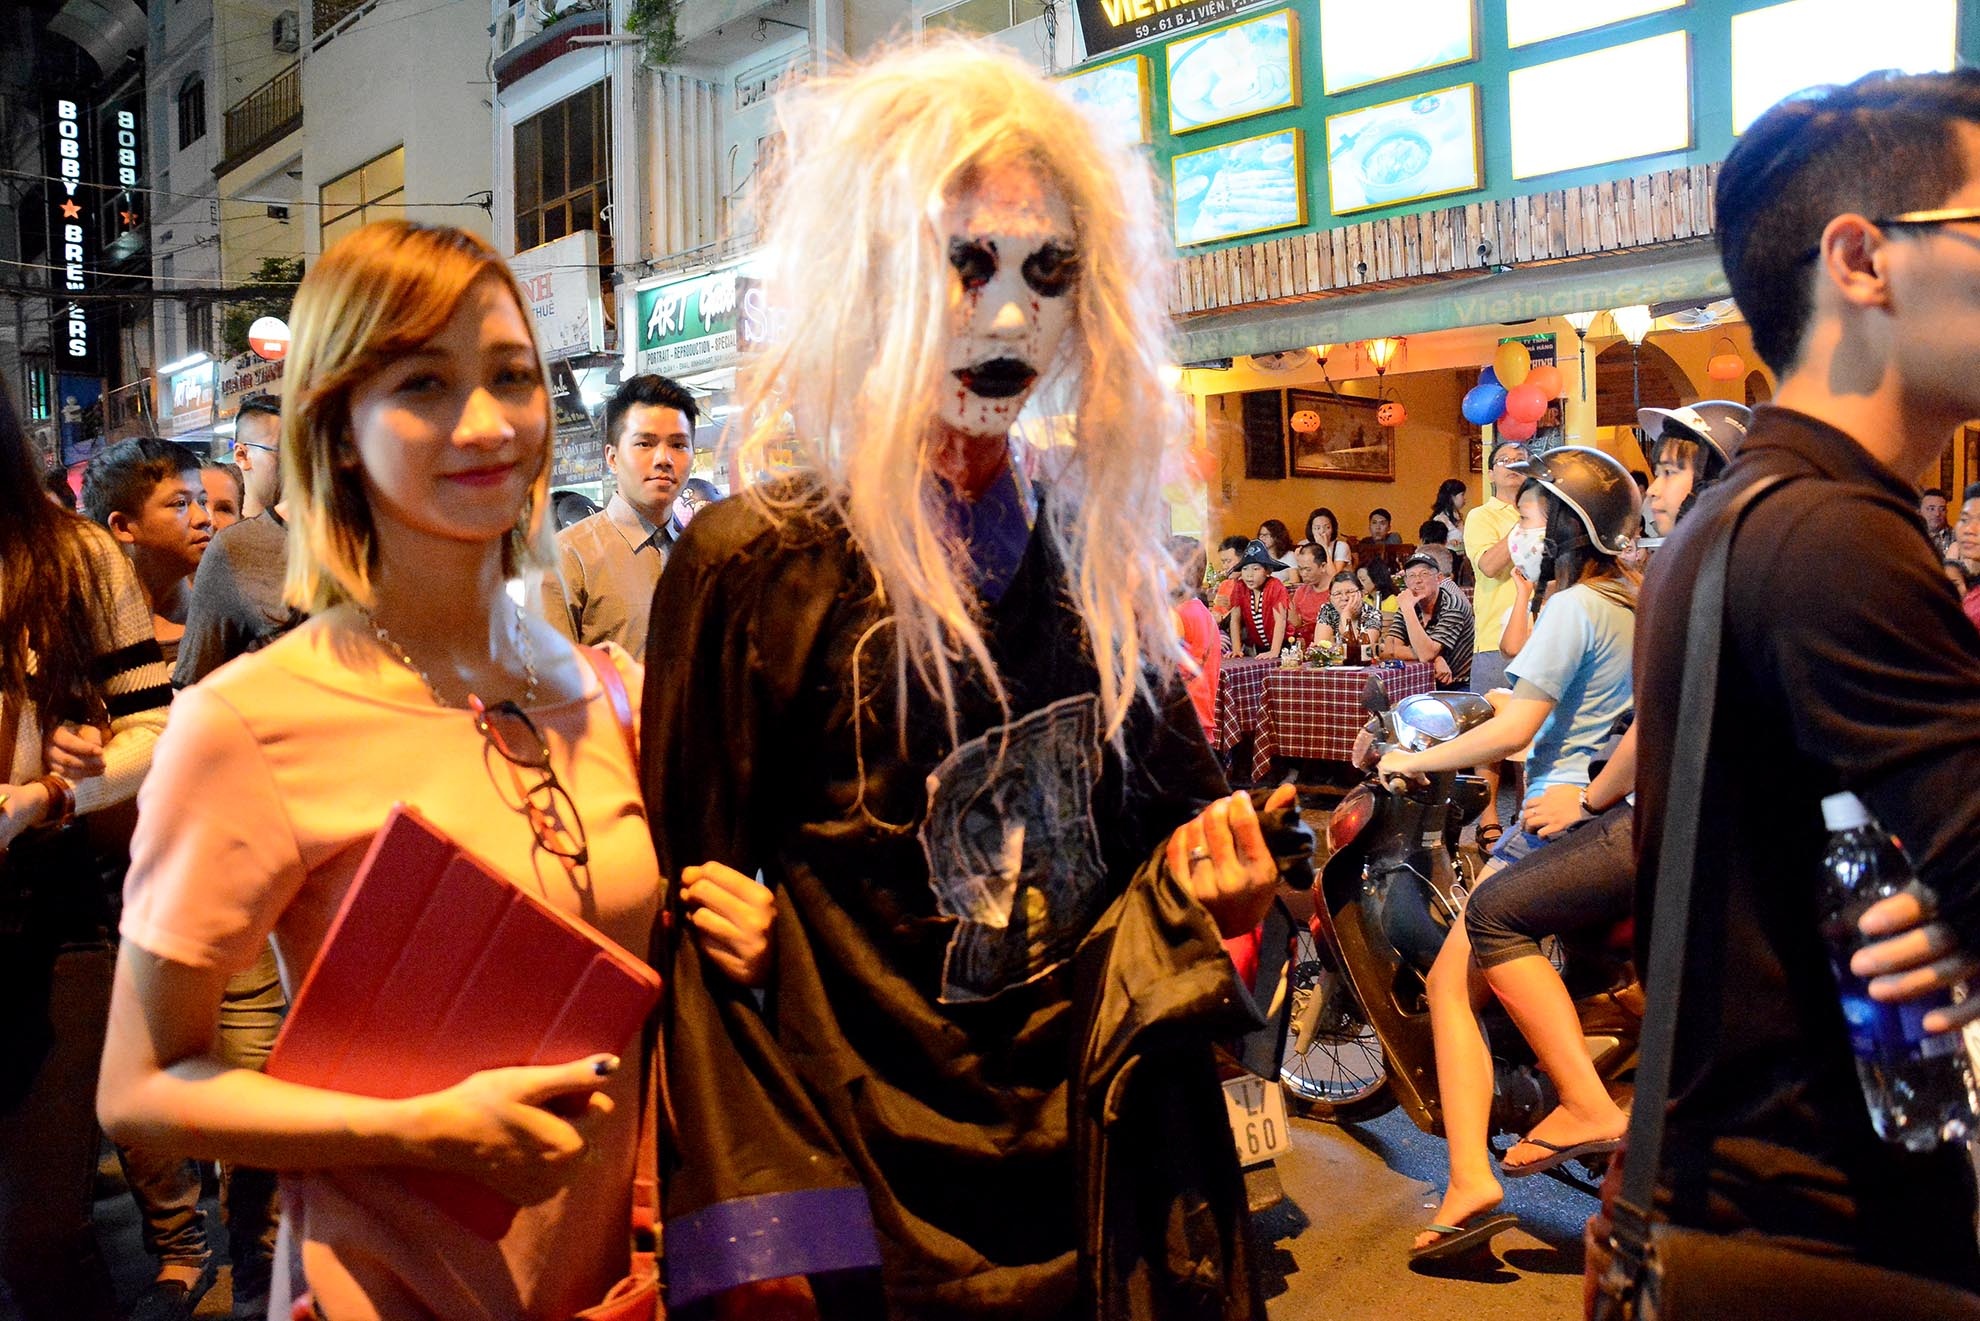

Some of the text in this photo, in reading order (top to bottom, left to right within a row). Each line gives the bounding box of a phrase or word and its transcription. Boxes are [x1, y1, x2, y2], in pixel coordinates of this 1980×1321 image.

[1135, 24, 1150, 38] 59
[1159, 17, 1173, 31] 61
[58, 99, 80, 196] BOBBY
[647, 290, 698, 341] ART
[1454, 275, 1688, 323] Vietnamese
[647, 347, 670, 365] PORTRAIT
[674, 341, 710, 359] REPRODUCTION
[1241, 1118, 1276, 1155] 60
